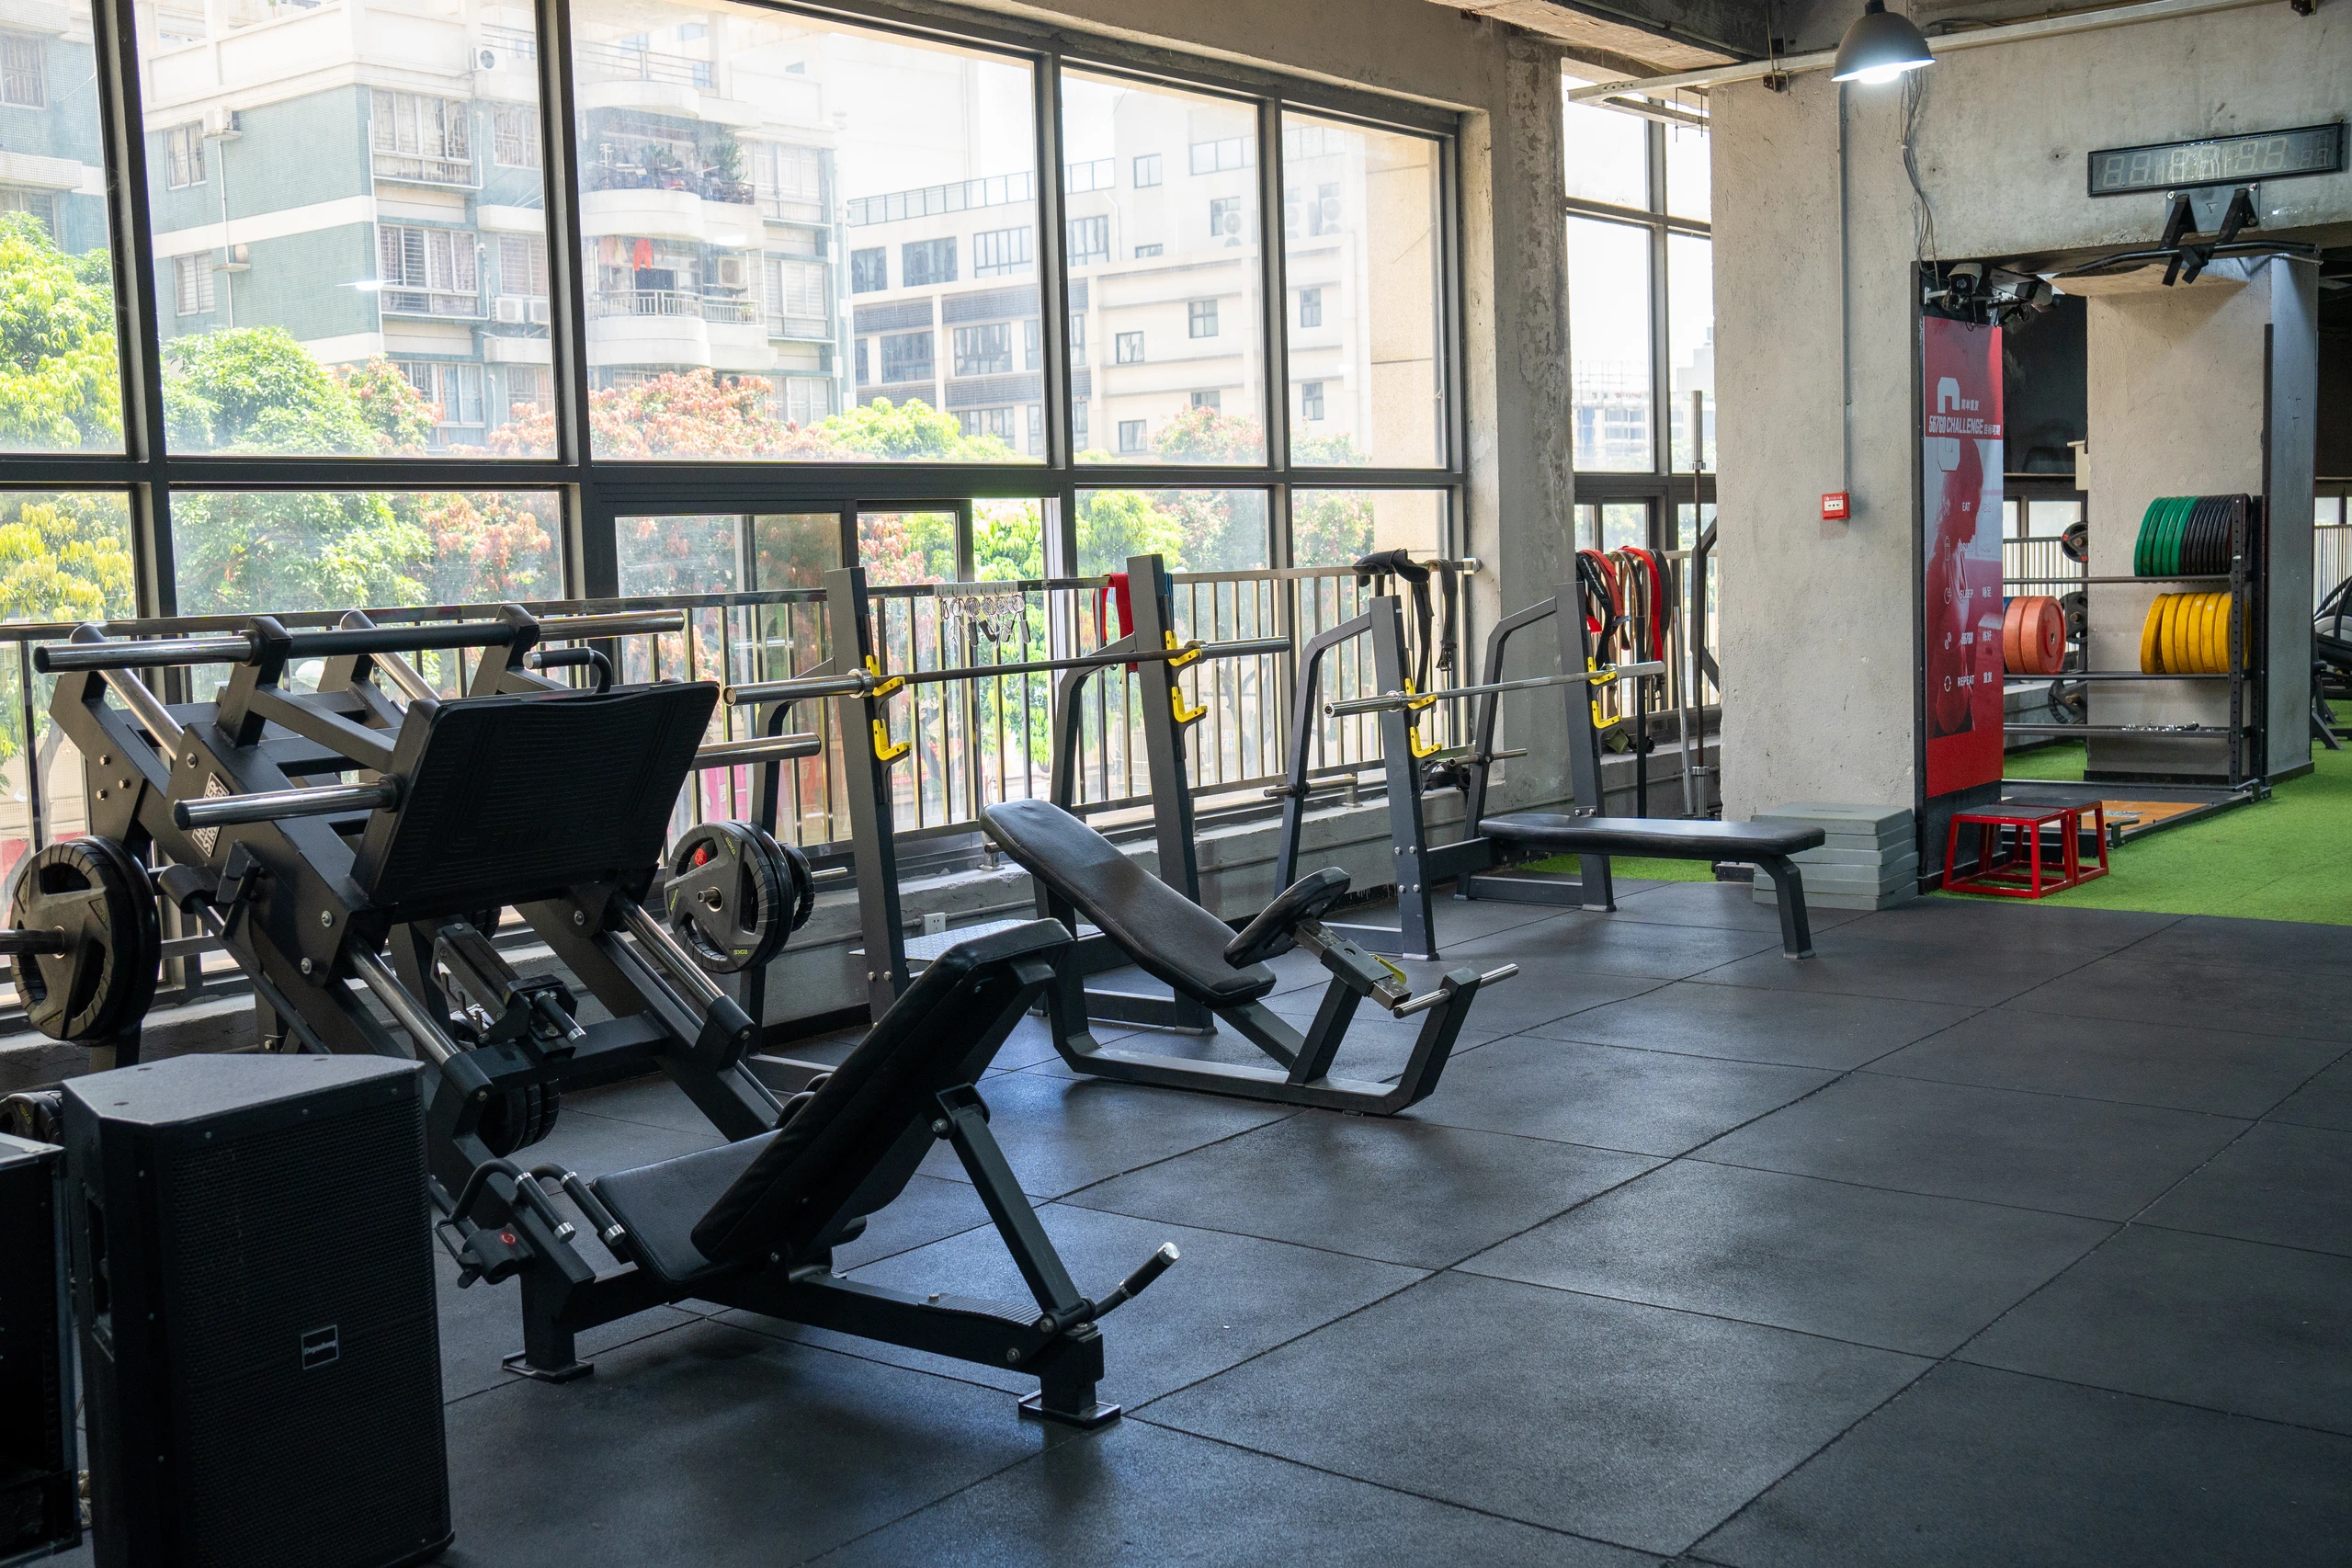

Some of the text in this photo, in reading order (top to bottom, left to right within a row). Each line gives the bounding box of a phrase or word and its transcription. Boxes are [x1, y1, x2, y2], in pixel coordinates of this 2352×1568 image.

[1947, 416, 1983, 435] CHALLENGE
[1961, 502, 1971, 511] EAT
[1960, 589, 1973, 599] SLEEP
[1958, 675, 1974, 687] REPEAT
